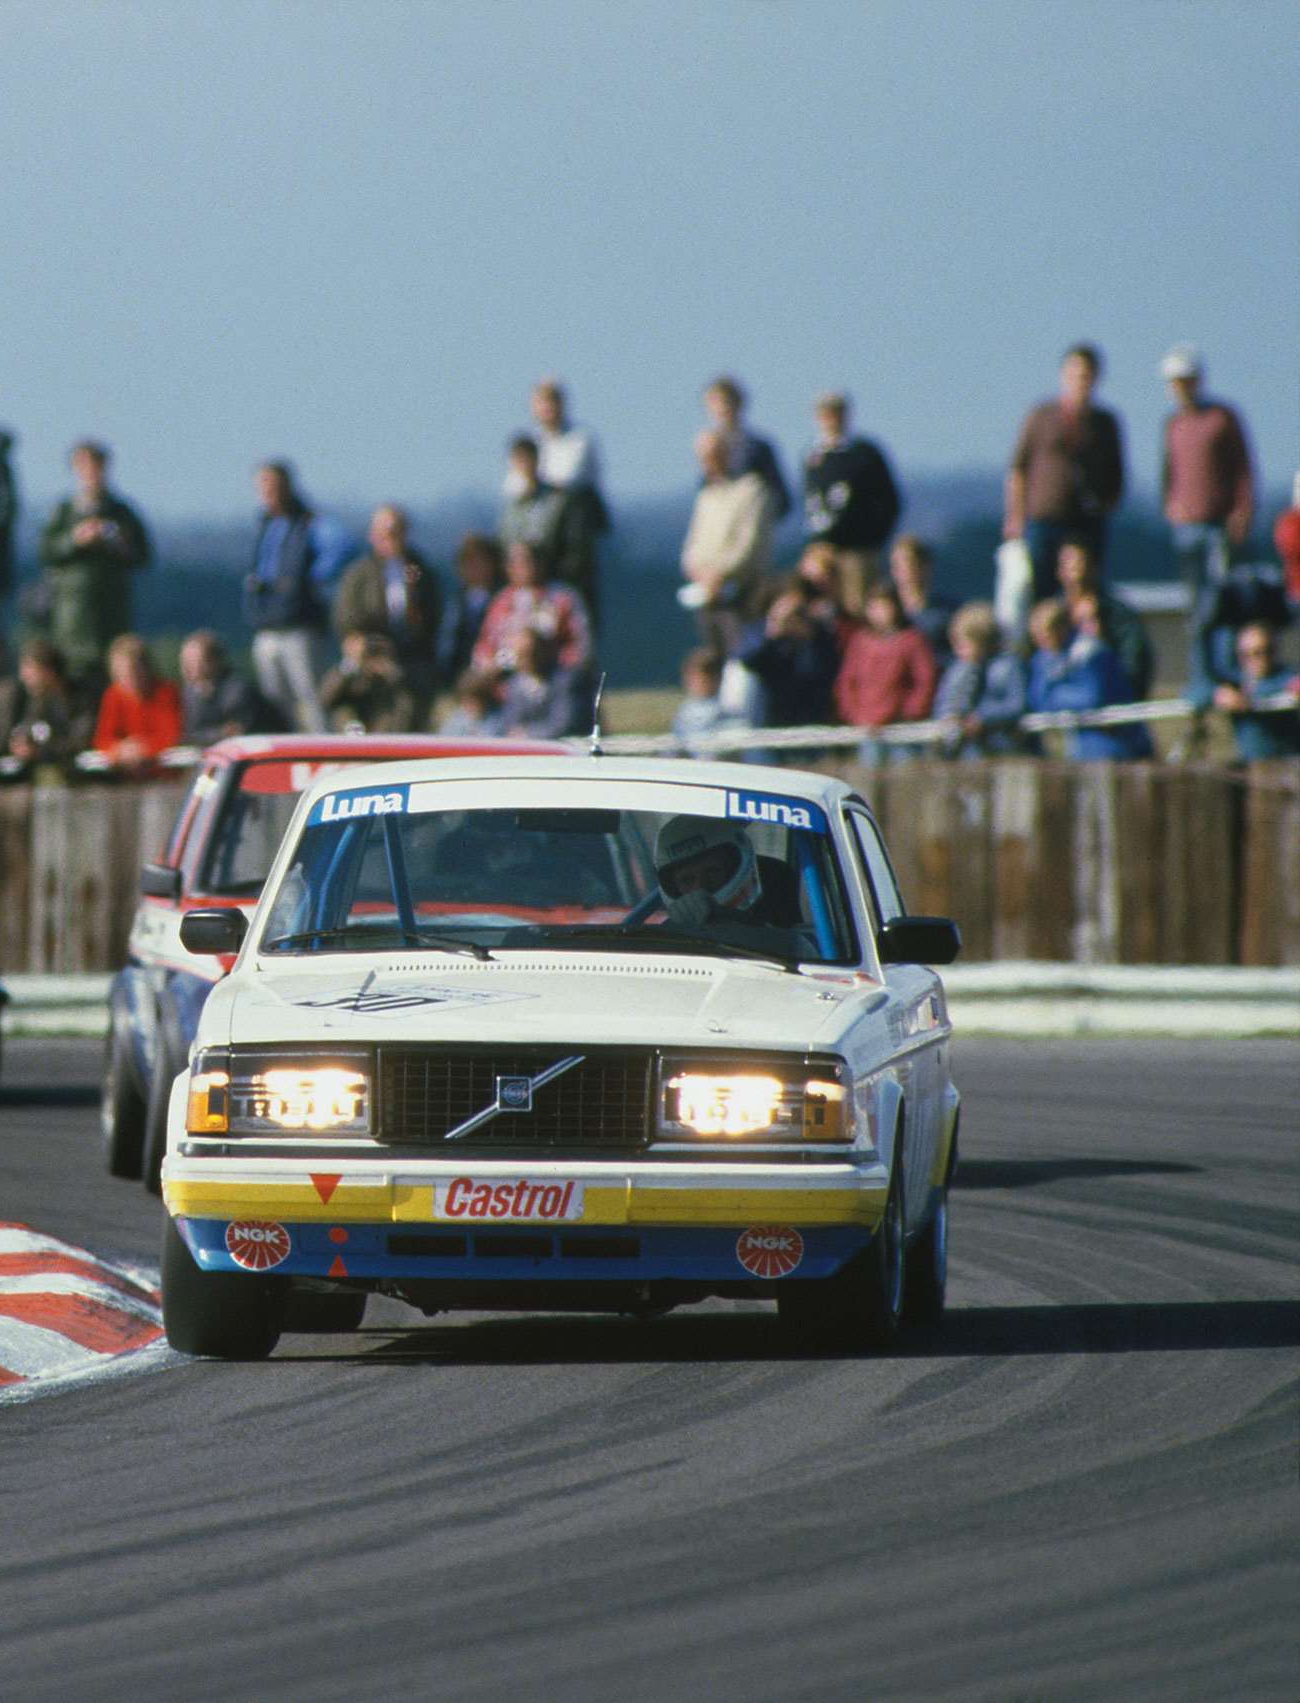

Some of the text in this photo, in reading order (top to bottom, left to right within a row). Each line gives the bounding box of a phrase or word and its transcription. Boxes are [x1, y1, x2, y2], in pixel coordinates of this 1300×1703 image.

[321, 793, 402, 821] Luna
[729, 793, 812, 828] Luna
[444, 1177, 575, 1217] Castrol
[234, 1228, 280, 1244] NGK
[746, 1236, 795, 1251] NGK
